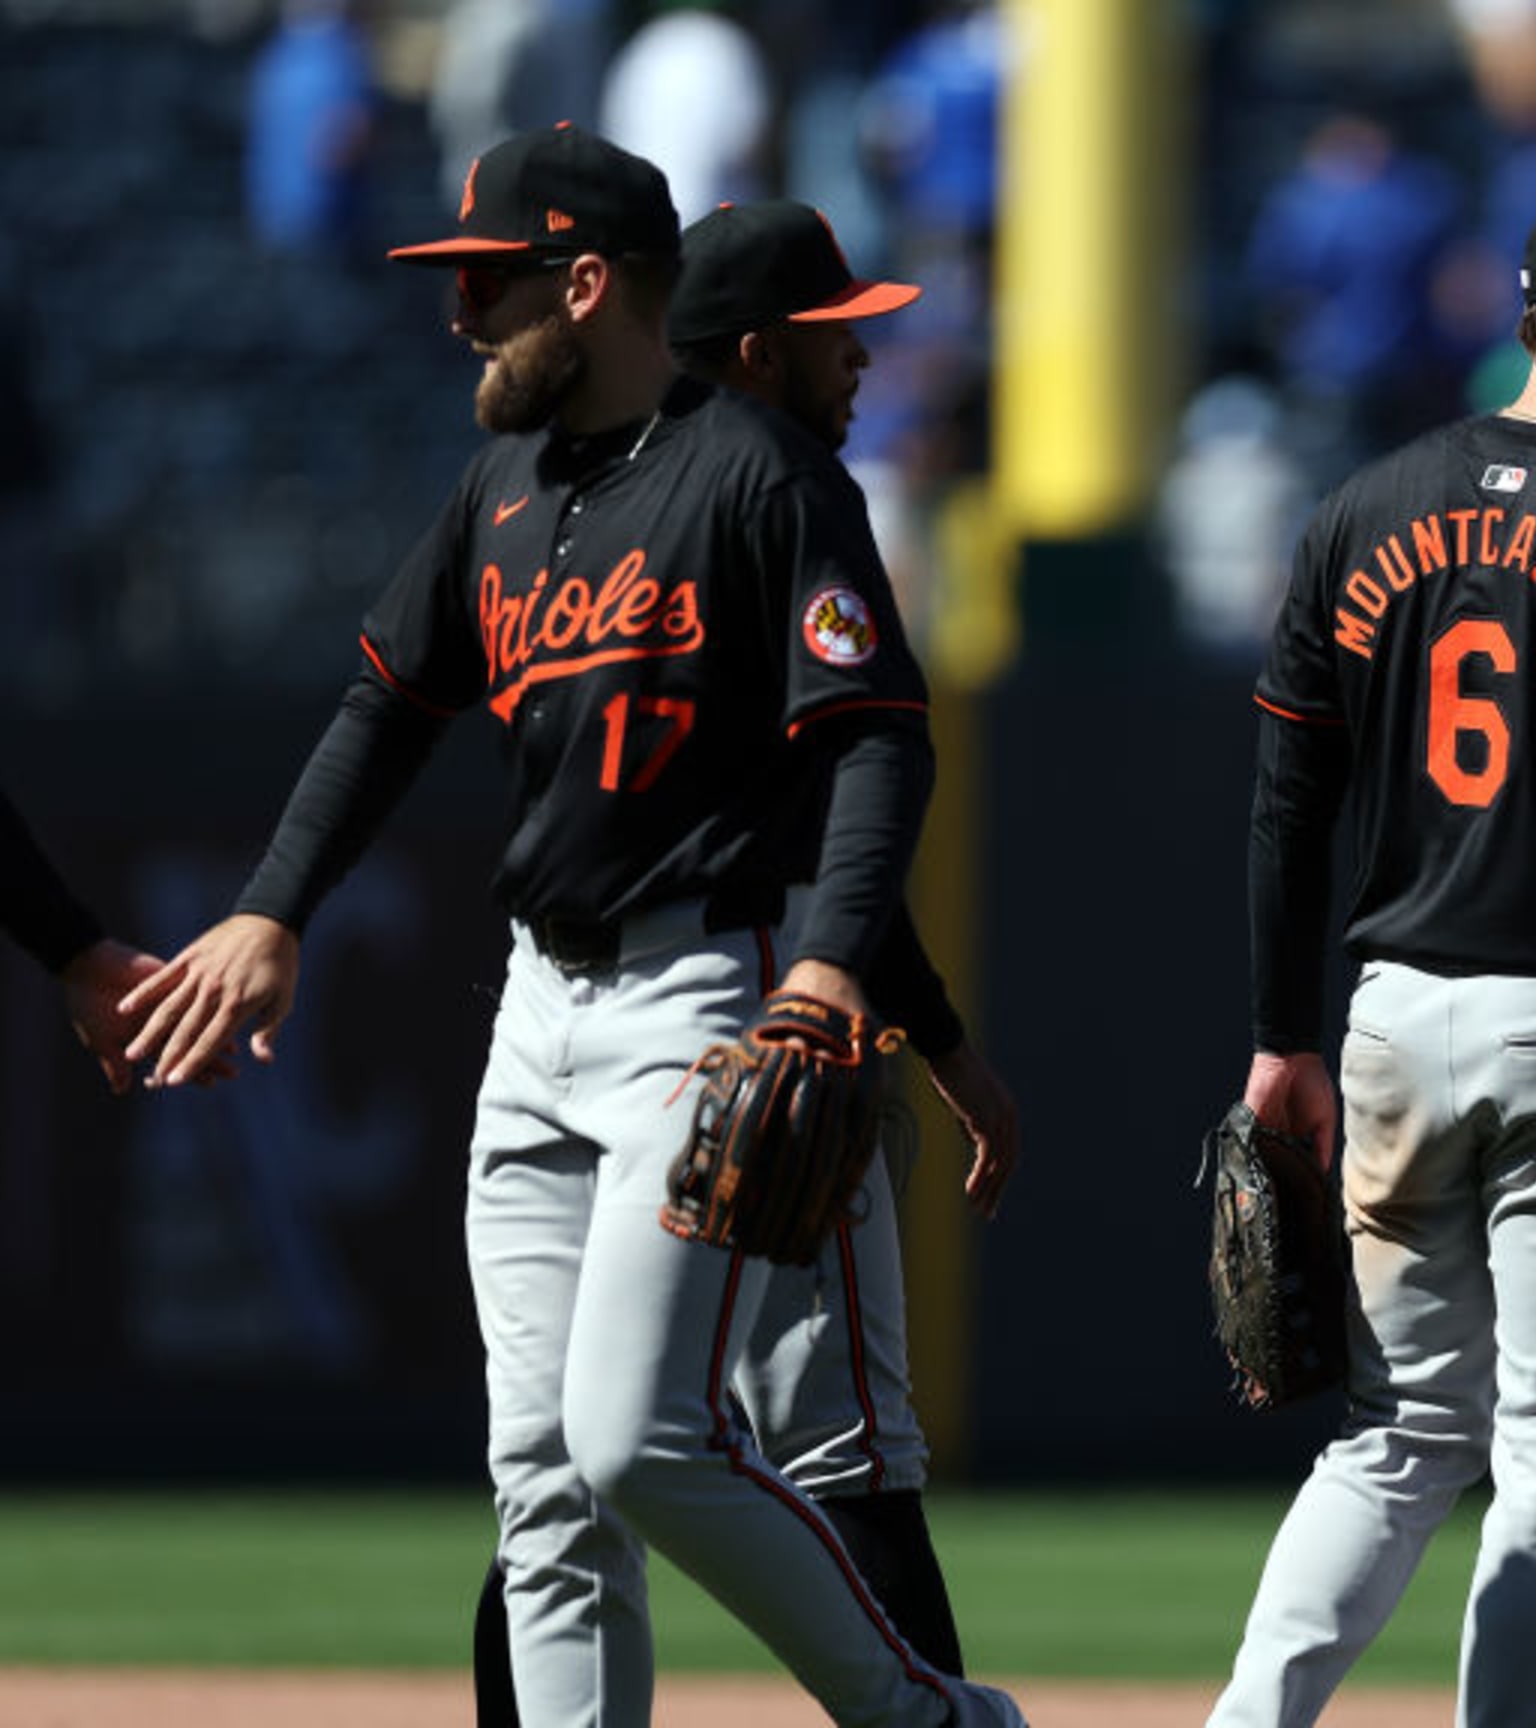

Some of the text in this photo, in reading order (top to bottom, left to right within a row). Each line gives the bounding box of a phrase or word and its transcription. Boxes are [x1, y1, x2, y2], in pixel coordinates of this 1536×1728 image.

[478, 548, 706, 688] Orioles
[600, 691, 695, 793] 17
[1426, 617, 1519, 808] 6
